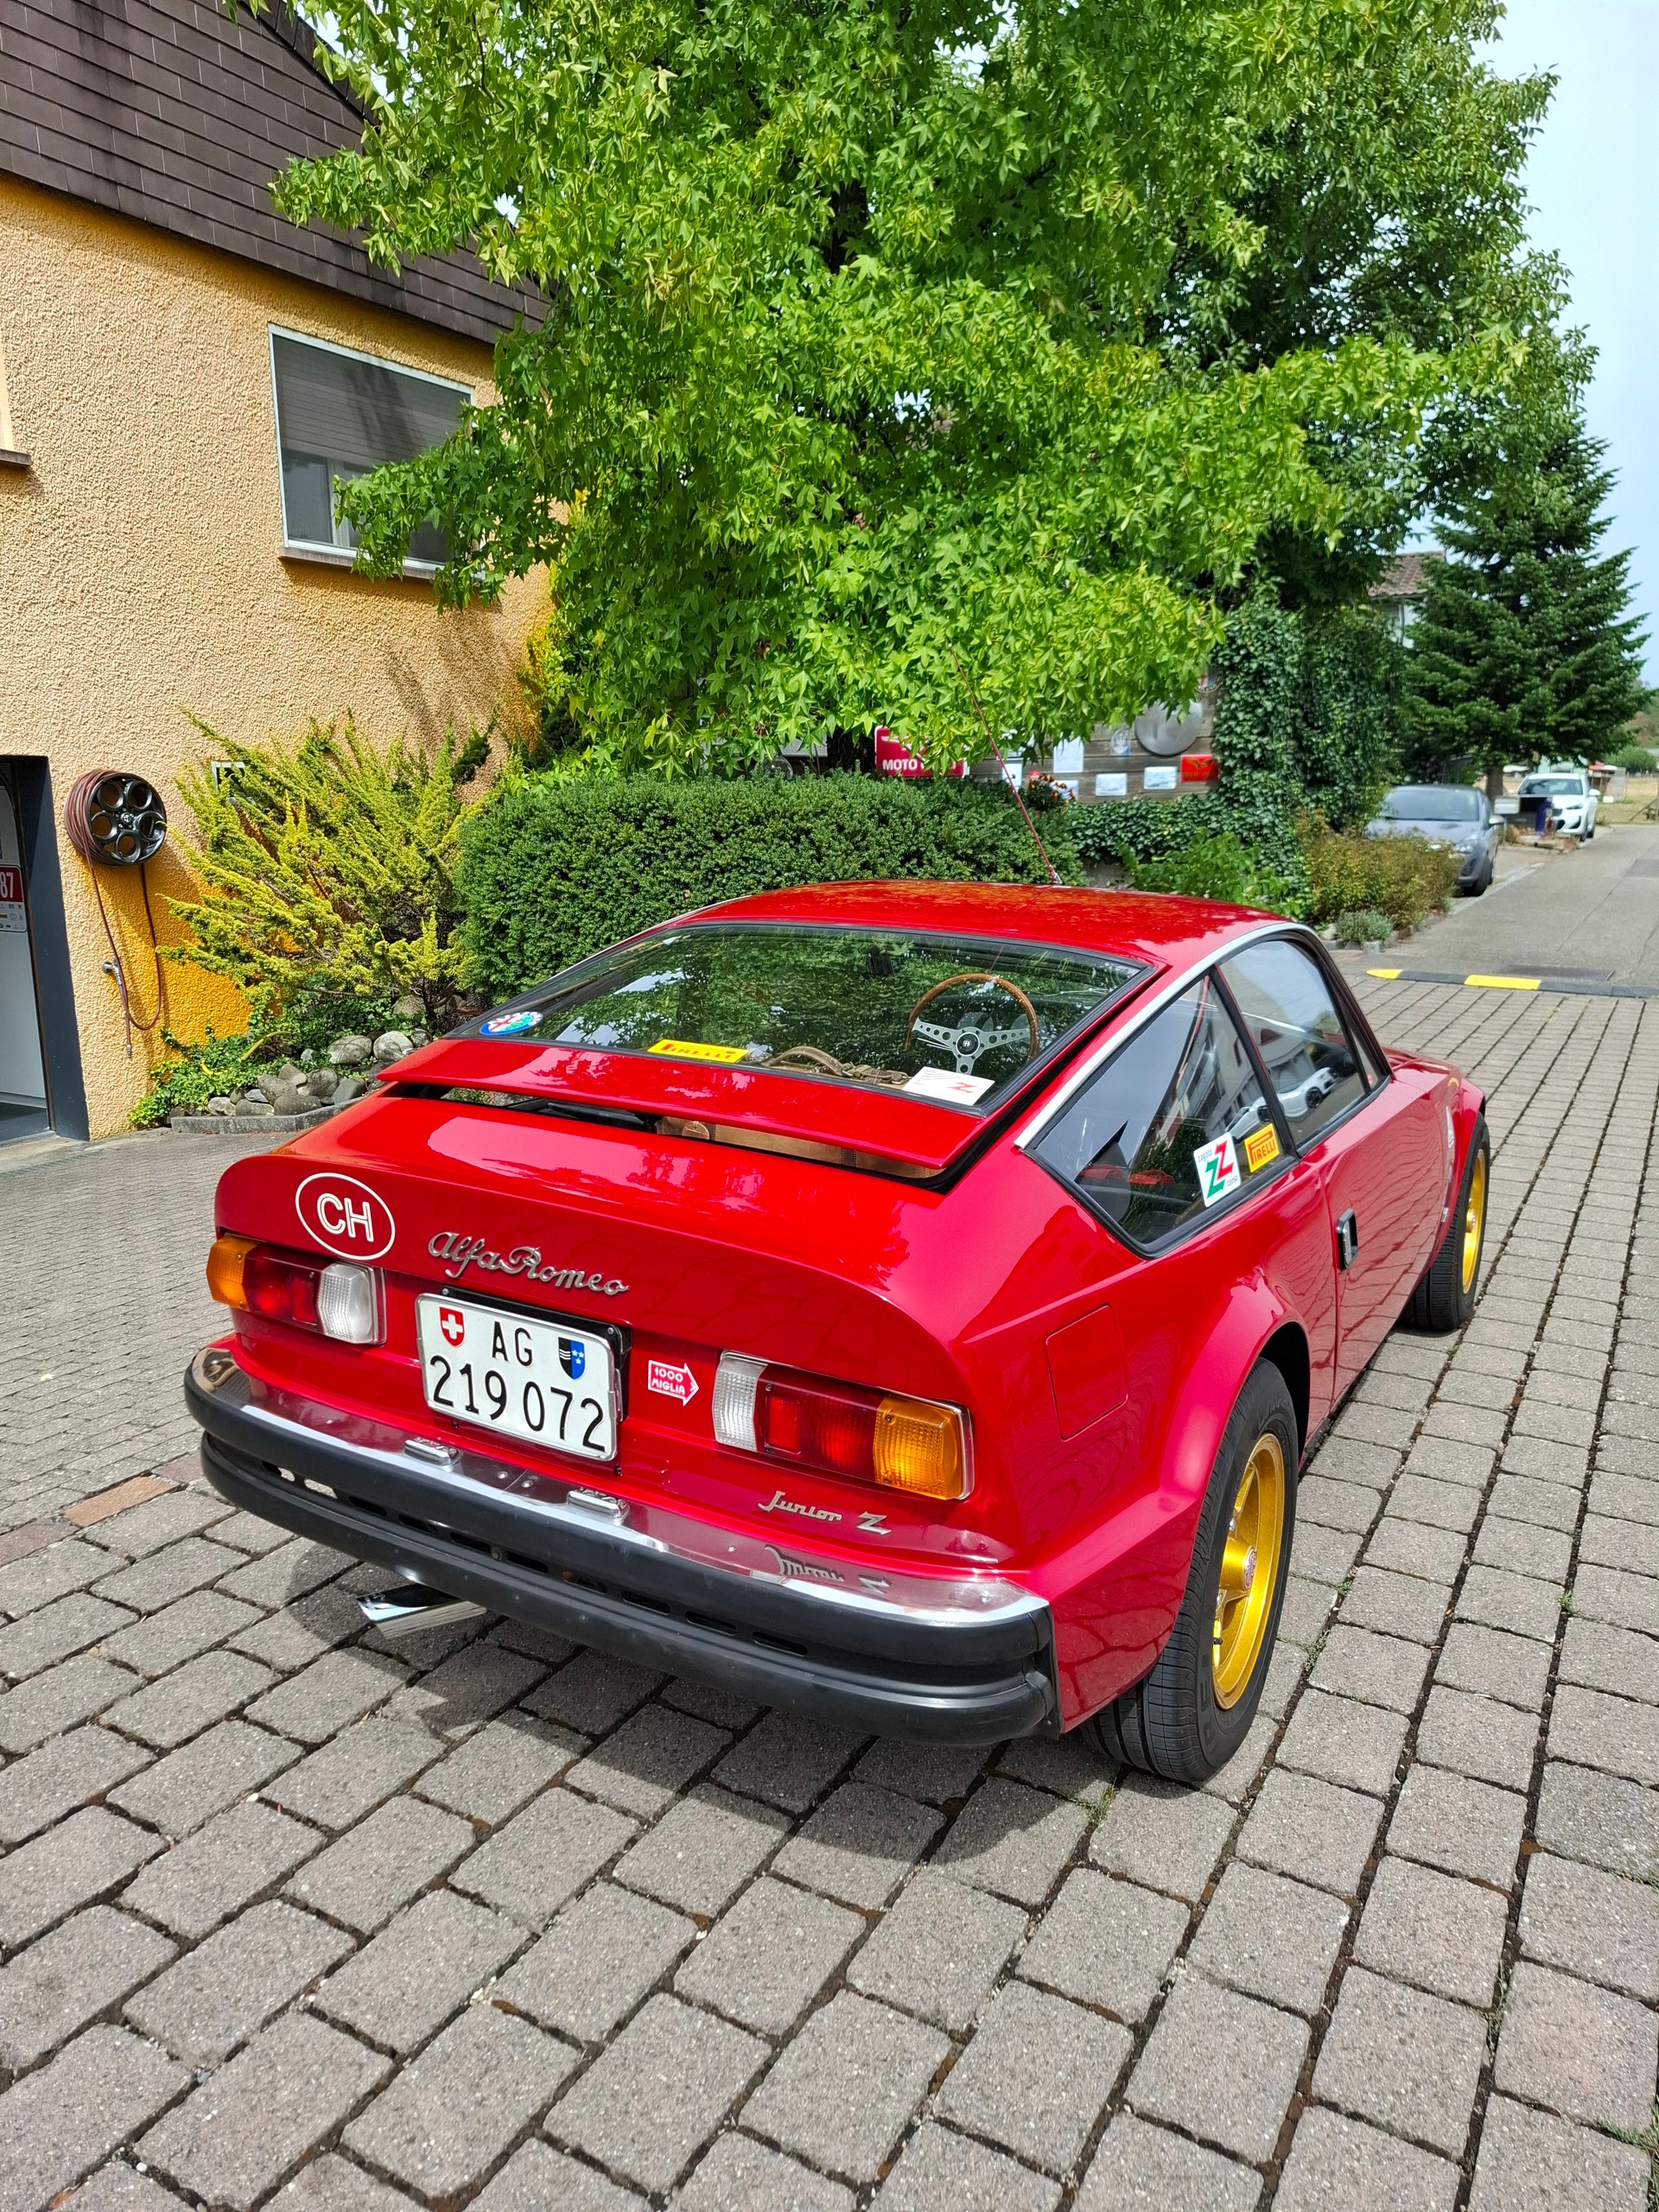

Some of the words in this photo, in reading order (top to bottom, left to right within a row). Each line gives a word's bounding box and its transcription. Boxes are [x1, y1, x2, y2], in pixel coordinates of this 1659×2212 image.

[882, 759, 918, 771] MOTO
[660, 1043, 736, 1059] PIRELLI
[1247, 1130, 1277, 1166] PIRELLI
[316, 1192, 374, 1243] CH
[428, 1230, 500, 1279] Alfa
[499, 1245, 630, 1296] Romeo
[491, 1320, 534, 1367] AG
[651, 1377, 685, 1395] MIGLIA
[654, 1366, 683, 1382] 1000
[429, 1354, 508, 1421] 219
[523, 1381, 606, 1453] 072
[758, 1490, 843, 1522] Junior
[855, 1510, 893, 1535] Z
